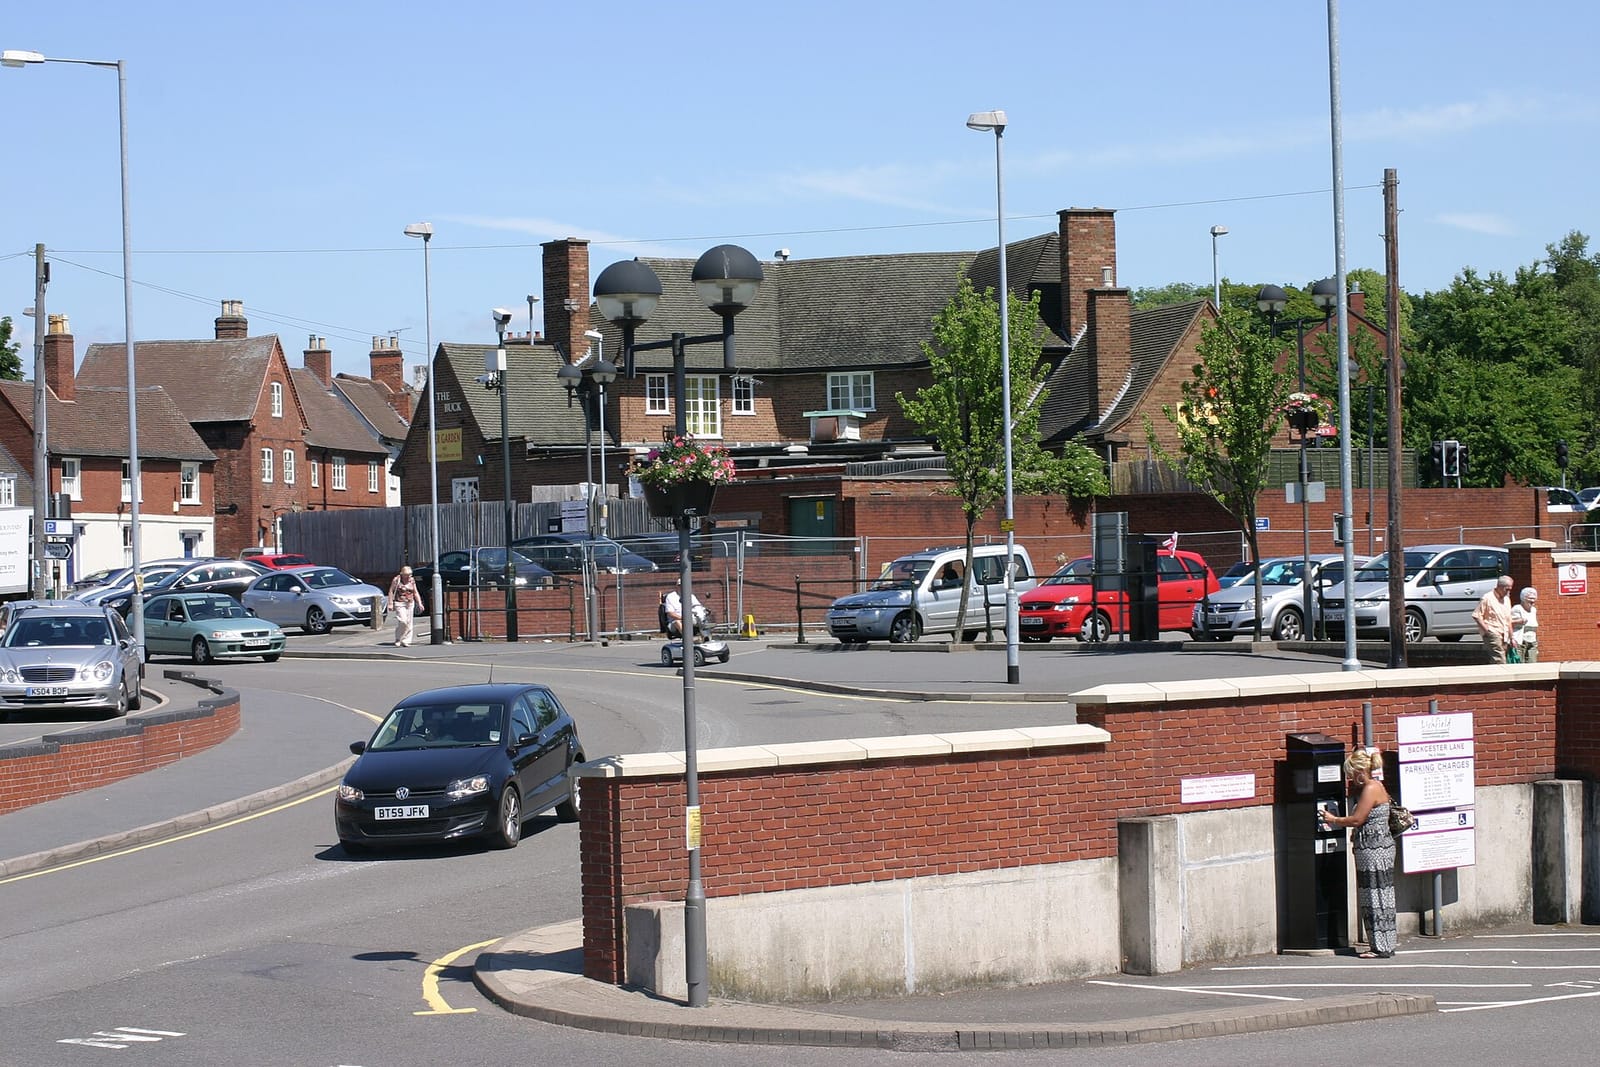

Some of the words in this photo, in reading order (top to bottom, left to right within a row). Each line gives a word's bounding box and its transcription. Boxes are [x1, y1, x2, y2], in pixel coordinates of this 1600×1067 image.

[436, 391, 451, 401] THE
[444, 402, 463, 412] BUCK
[47, 522, 55, 532] P
[31, 687, 50, 696] KS04
[1407, 744, 1448, 754] BACKCESTER
[1449, 742, 1465, 751] LANE
[1405, 763, 1435, 774] PARKING
[1437, 760, 1470, 771] CHARGES
[379, 808, 404, 818] BT59
[406, 806, 425, 817] JFK
